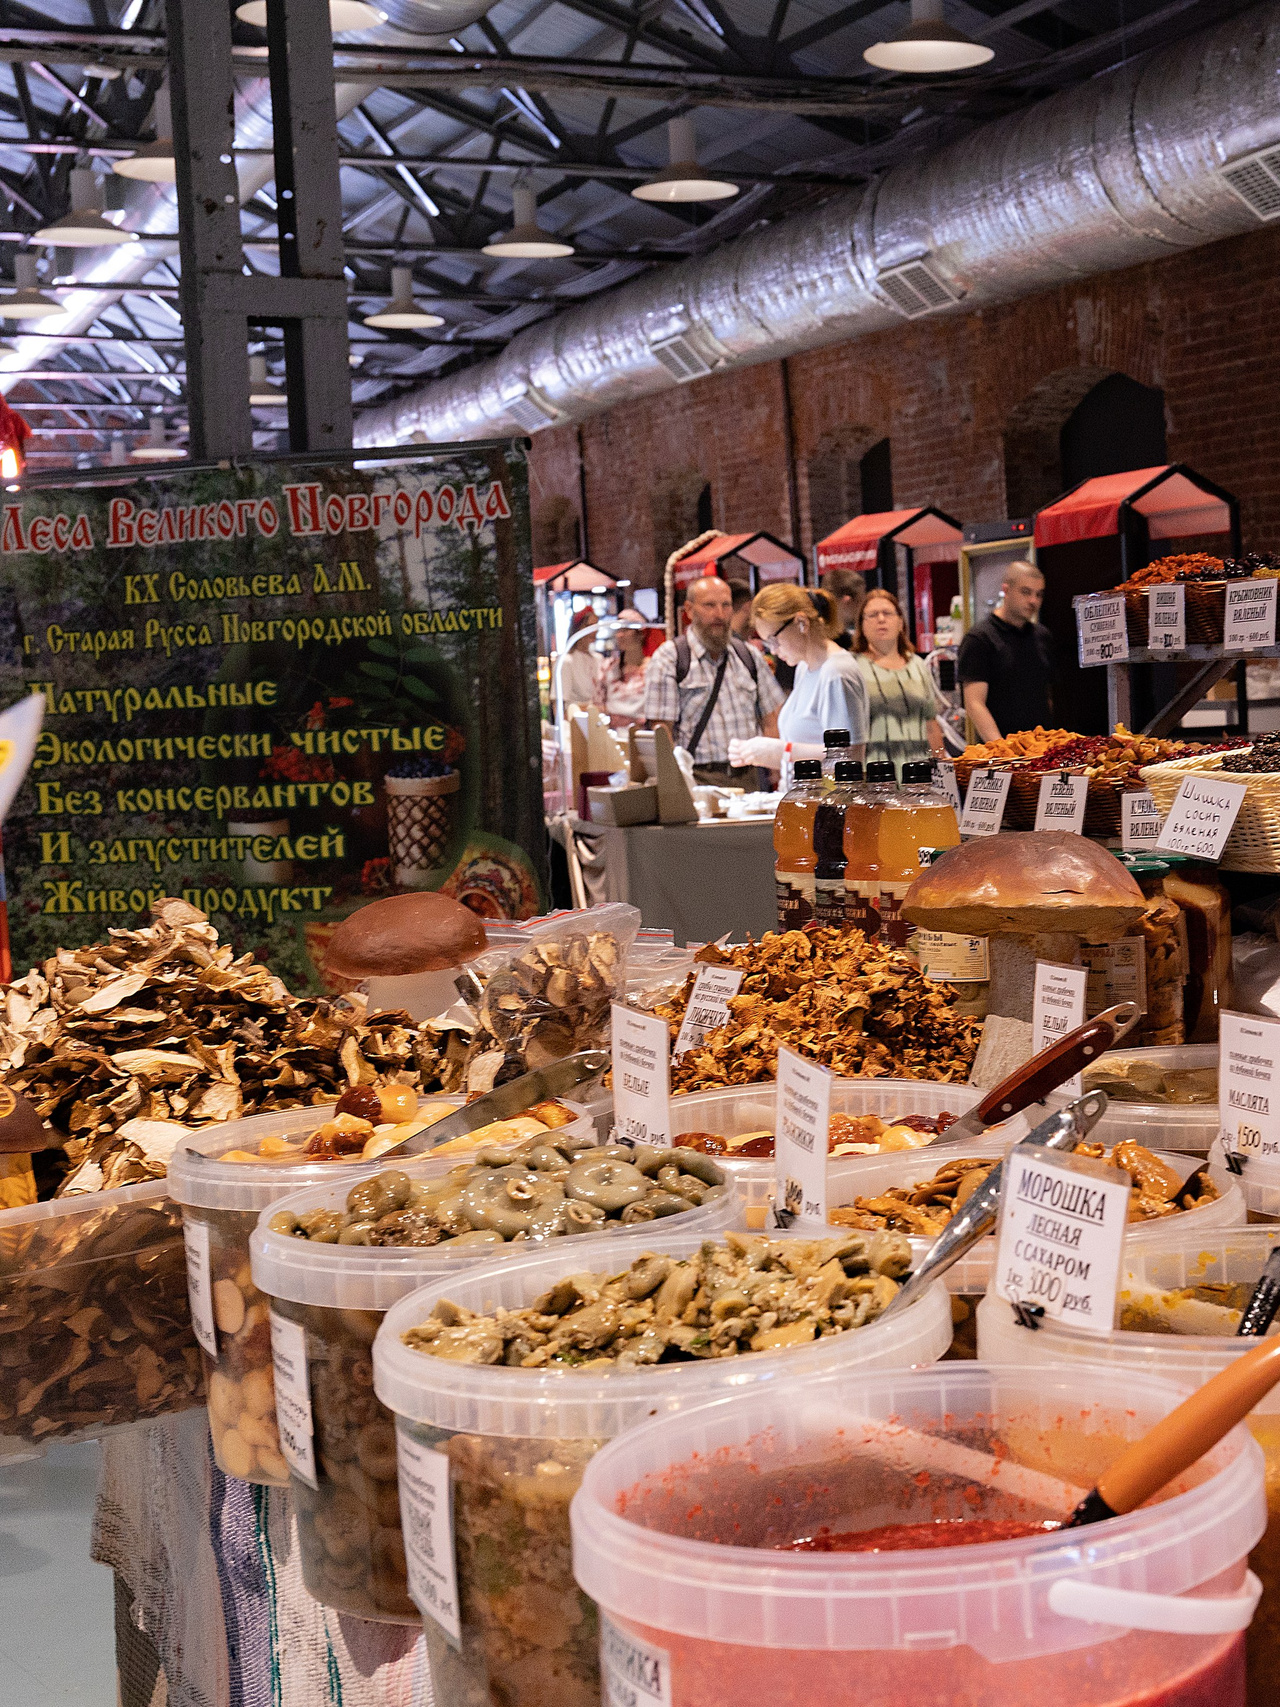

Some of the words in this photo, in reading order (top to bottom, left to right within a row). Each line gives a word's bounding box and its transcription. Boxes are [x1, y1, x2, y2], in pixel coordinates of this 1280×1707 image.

[1, 502, 95, 554] Леса
[107, 498, 279, 549] Великого
[283, 480, 511, 538] Новгорода
[124, 577, 159, 604] КХ
[169, 571, 301, 602] Соловьева
[313, 561, 372, 593] А.М.
[1229, 587, 1274, 603] КРЫЖОВНИК
[1233, 603, 1266, 621] ВЯЛЕНЫЙ
[24, 632, 40, 654] г.
[46, 622, 135, 660] Старая
[145, 619, 212, 657] Русса
[221, 610, 392, 648] Новгородской
[402, 607, 502, 634] области
[33, 731, 271, 768] Экологически
[297, 725, 445, 753] чистые
[37, 781, 102, 815] Без
[117, 780, 375, 820] консервантов
[42, 831, 72, 864] И
[90, 828, 346, 871] загустителей
[688, 1007, 726, 1026] ЛИСИЧКИ
[1043, 1015, 1068, 1032] БЕЛЫЙ
[624, 1073, 650, 1094] БЕЛЫЕ
[1228, 1088, 1269, 1113] МАСЛЯТА
[1238, 1125, 1260, 1148] 1500
[1262, 1142, 1280, 1155] руб.
[1017, 1169, 1106, 1221] МОРОШКА
[1027, 1214, 1083, 1246] ЛЕСНАЯ
[1015, 1240, 1023, 1257] С
[1023, 1241, 1092, 1280] САХАРОМ
[1063, 1293, 1092, 1310] руб.
